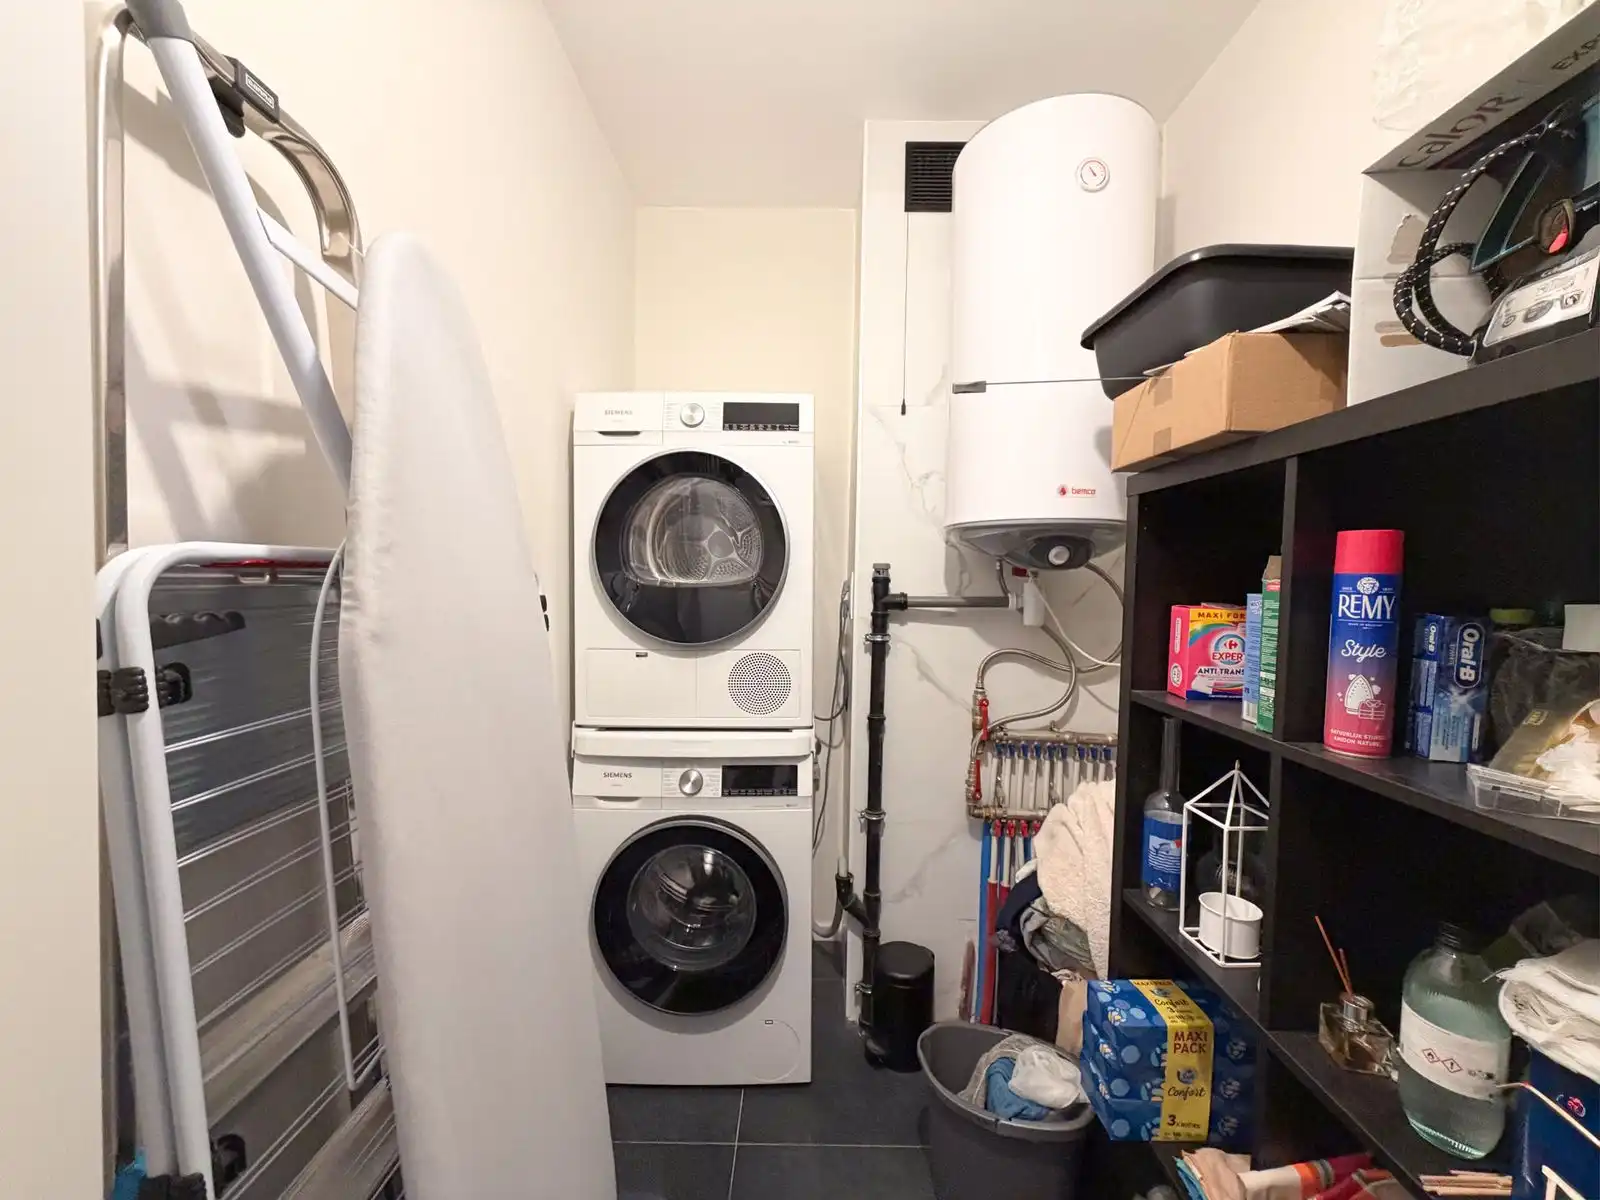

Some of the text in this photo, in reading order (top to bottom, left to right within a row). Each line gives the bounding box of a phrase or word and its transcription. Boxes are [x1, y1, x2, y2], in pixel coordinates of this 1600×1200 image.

[1338, 593, 1396, 620] REMY
[1197, 611, 1223, 620] MAXI
[1428, 625, 1437, 653] Oral-B
[1211, 651, 1246, 661] EXPER
[1341, 639, 1387, 663] Style
[1459, 628, 1480, 682] Oral-B
[603, 771, 633, 779] SIEMENS
[1173, 1031, 1209, 1042] MAXI
[1173, 1042, 1207, 1054] PACK
[1167, 1086, 1206, 1101] Confort
[1167, 1114, 1176, 1127] 3
